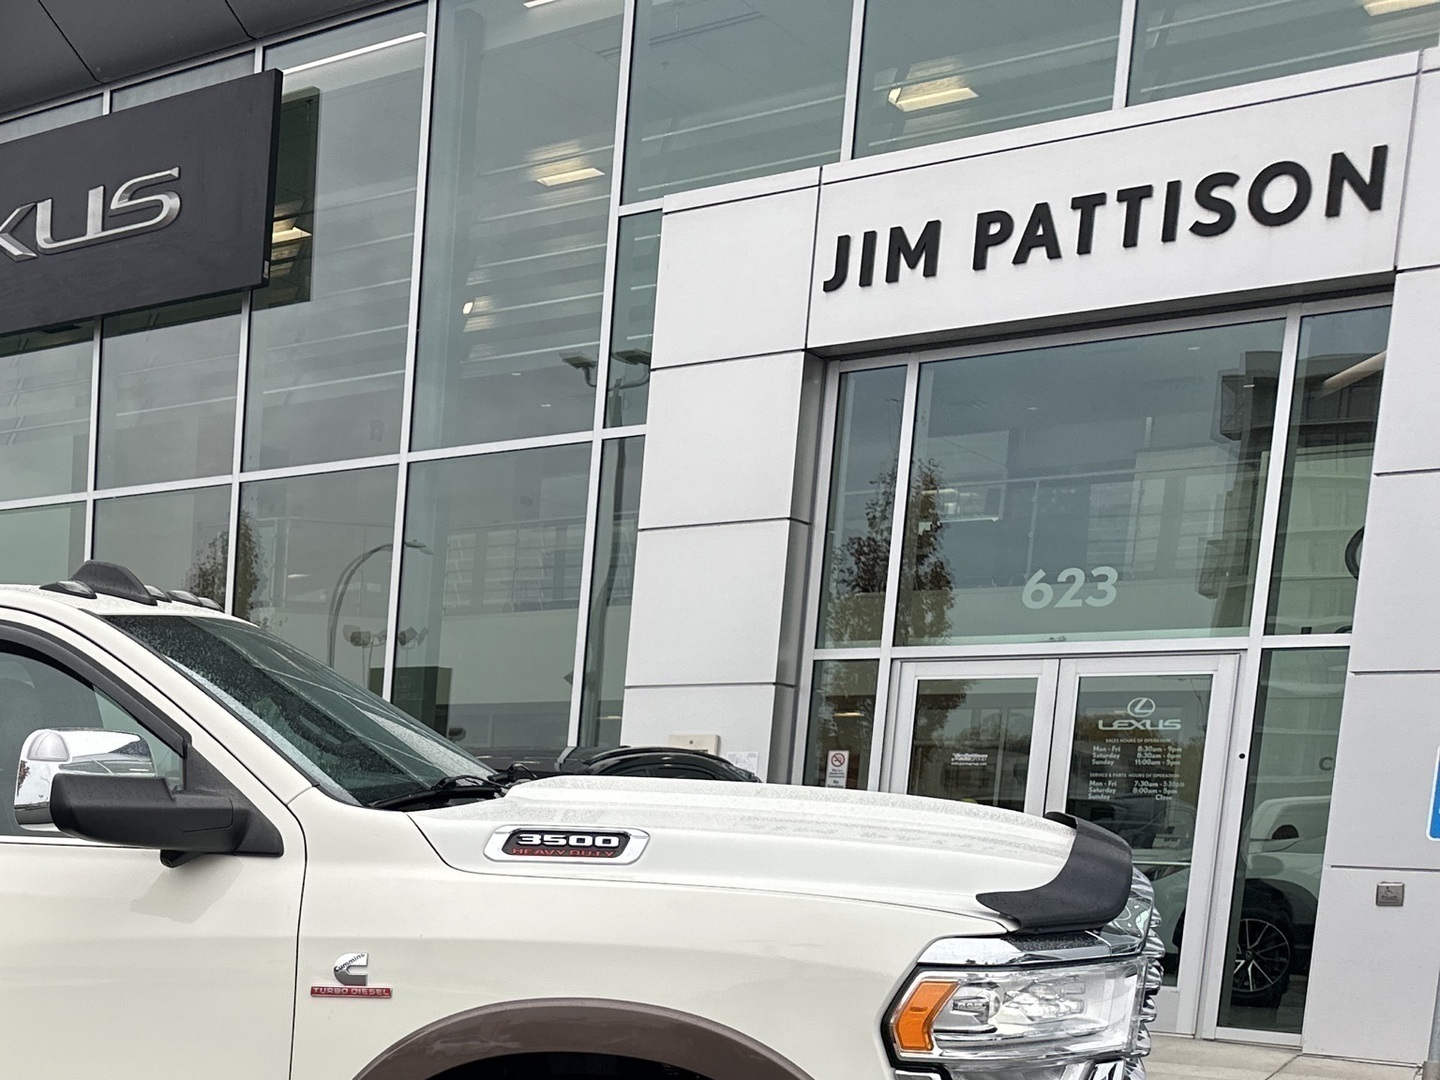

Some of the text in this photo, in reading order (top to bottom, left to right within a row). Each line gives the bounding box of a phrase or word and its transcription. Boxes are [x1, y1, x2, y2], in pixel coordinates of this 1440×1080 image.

[822, 144, 1389, 294] JIM PATTISON
[1021, 565, 1119, 610] 623
[1098, 719, 1182, 730] LEXUS
[1091, 752, 1120, 760] Saturday
[1087, 793, 1111, 801] Sunday
[516, 832, 621, 848] 3500
[512, 848, 617, 857] HEAVY DUTY
[333, 953, 365, 972] Cummins
[312, 987, 390, 996] TURBO DIESEL
